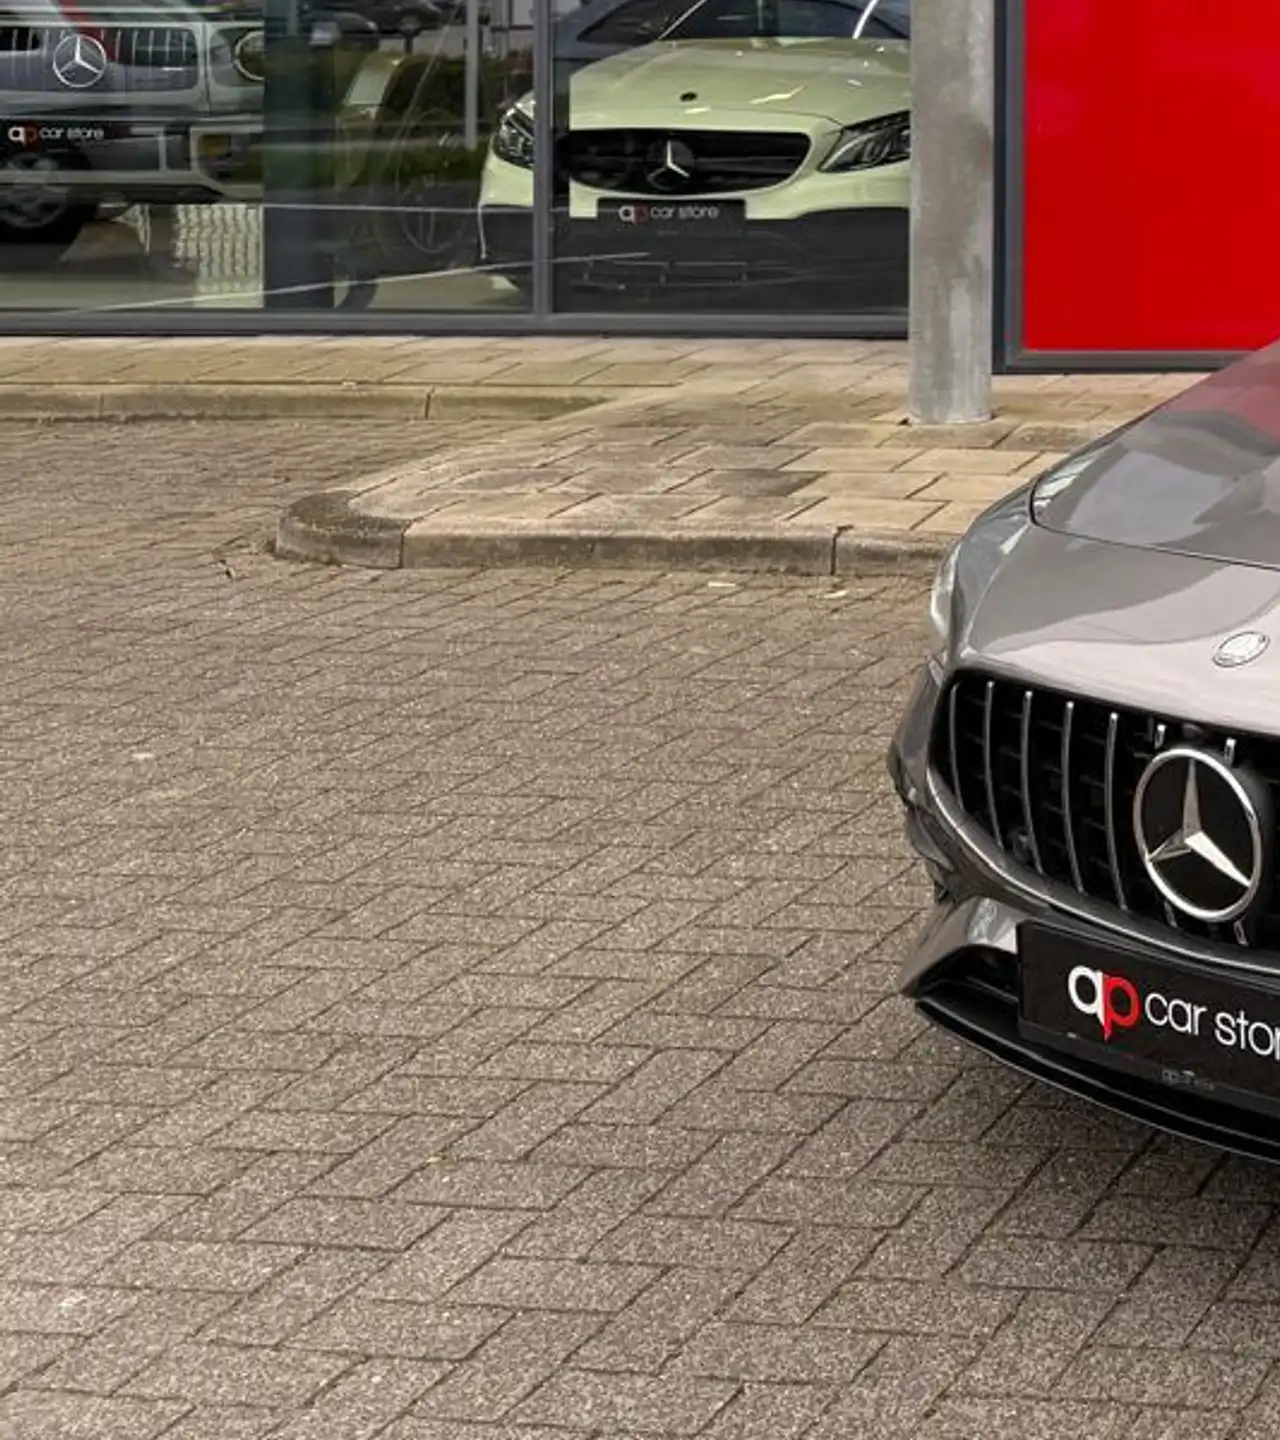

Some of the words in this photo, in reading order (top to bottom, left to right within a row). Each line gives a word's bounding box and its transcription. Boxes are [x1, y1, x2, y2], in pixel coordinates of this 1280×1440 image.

[39, 127, 65, 140] car
[651, 206, 675, 220] car
[1067, 964, 1142, 1042] ap
[1144, 992, 1208, 1036] car
